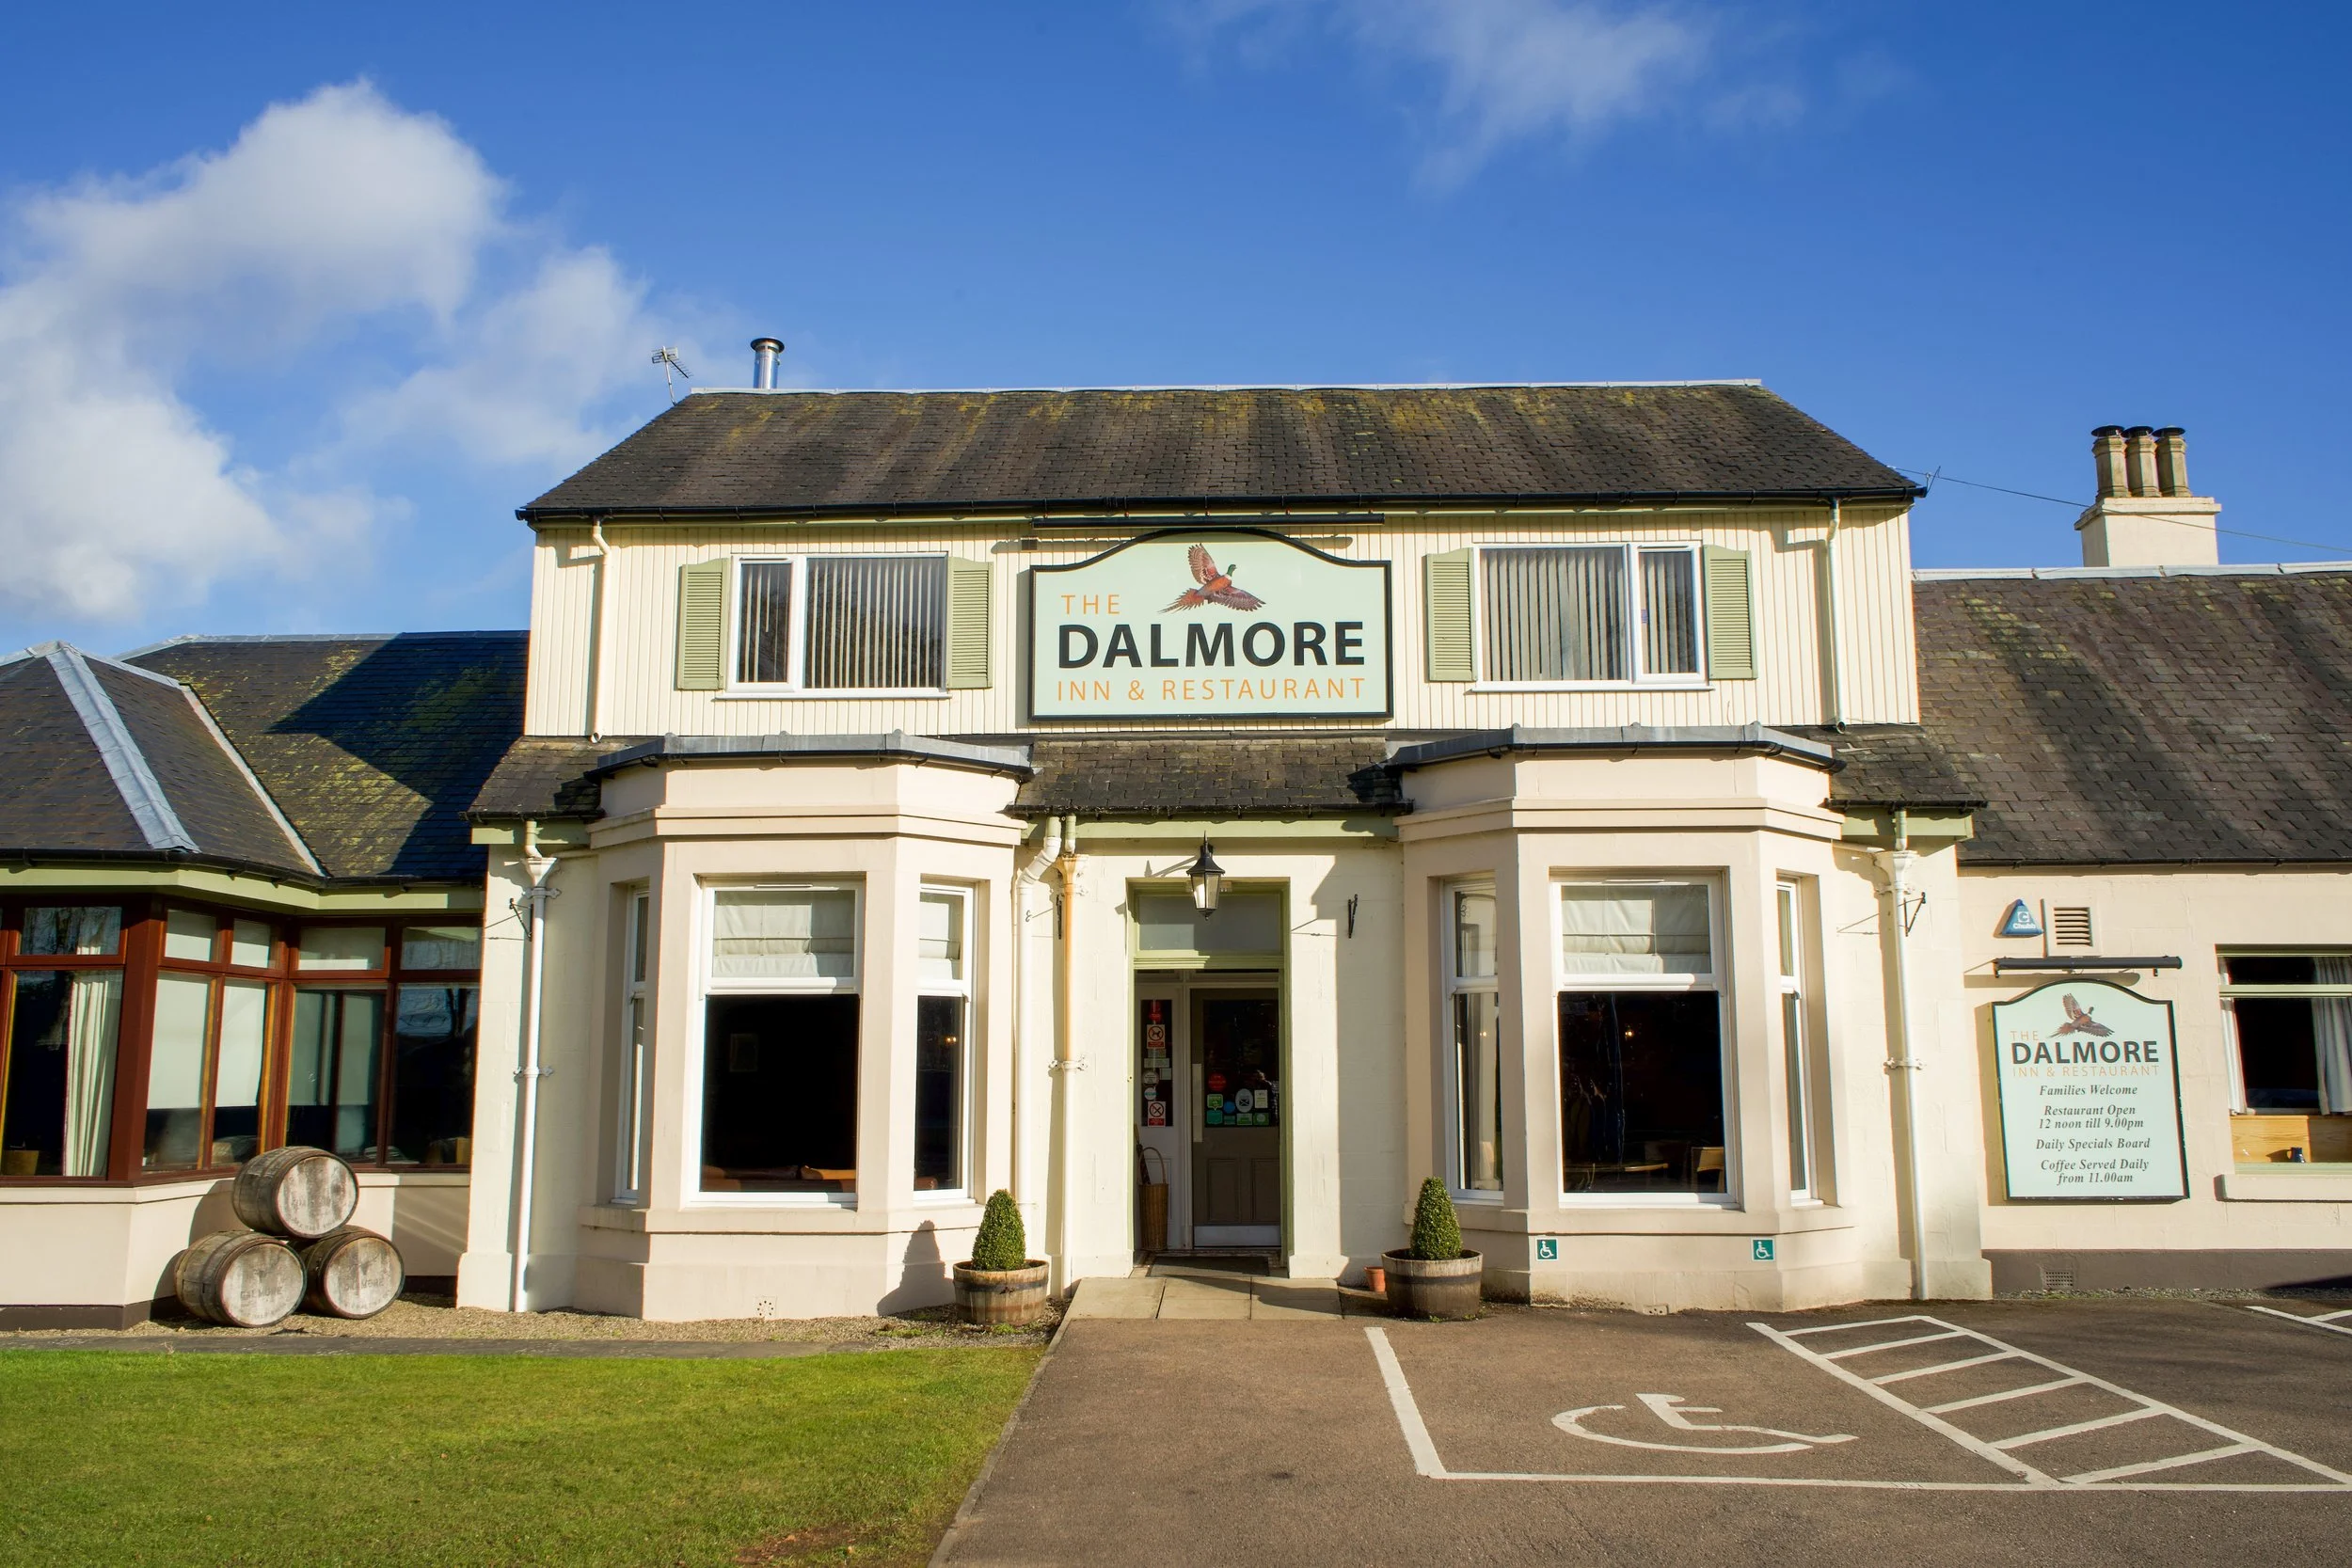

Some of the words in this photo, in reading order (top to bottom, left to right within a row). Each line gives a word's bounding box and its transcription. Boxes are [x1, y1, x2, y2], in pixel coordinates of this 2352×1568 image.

[1060, 594, 1120, 615] THE
[1058, 621, 1365, 669] DALMORE
[1057, 680, 1110, 701] INN
[1127, 679, 1145, 701] &
[1162, 677, 1366, 701] RESTAURANT
[2010, 1031, 2040, 1041] THE
[2011, 1040, 2159, 1064] DALMORE
[2012, 1066, 2040, 1077] INN
[2046, 1066, 2055, 1077] &
[2062, 1065, 2159, 1077] RESTAURANT
[2039, 1085, 2086, 1096] Families
[2090, 1085, 2137, 1095] Welcome
[2043, 1105, 2104, 1116] Restaurant
[2107, 1104, 2136, 1117] Open
[2039, 1118, 2051, 1129] 12
[2055, 1120, 2082, 1129] noon
[2085, 1118, 2101, 1129] till
[2104, 1117, 2144, 1131] 9.00pm
[2036, 1138, 2064, 1151] Daily
[2068, 1138, 2113, 1151] Specials
[2117, 1138, 2151, 1148] Board
[2041, 1159, 2076, 1173] Coffee
[2079, 1159, 2116, 1169] Served
[2120, 1158, 2149, 1171] Daily
[2057, 1172, 2084, 1186] from
[2088, 1172, 2133, 1183] 11.00am
